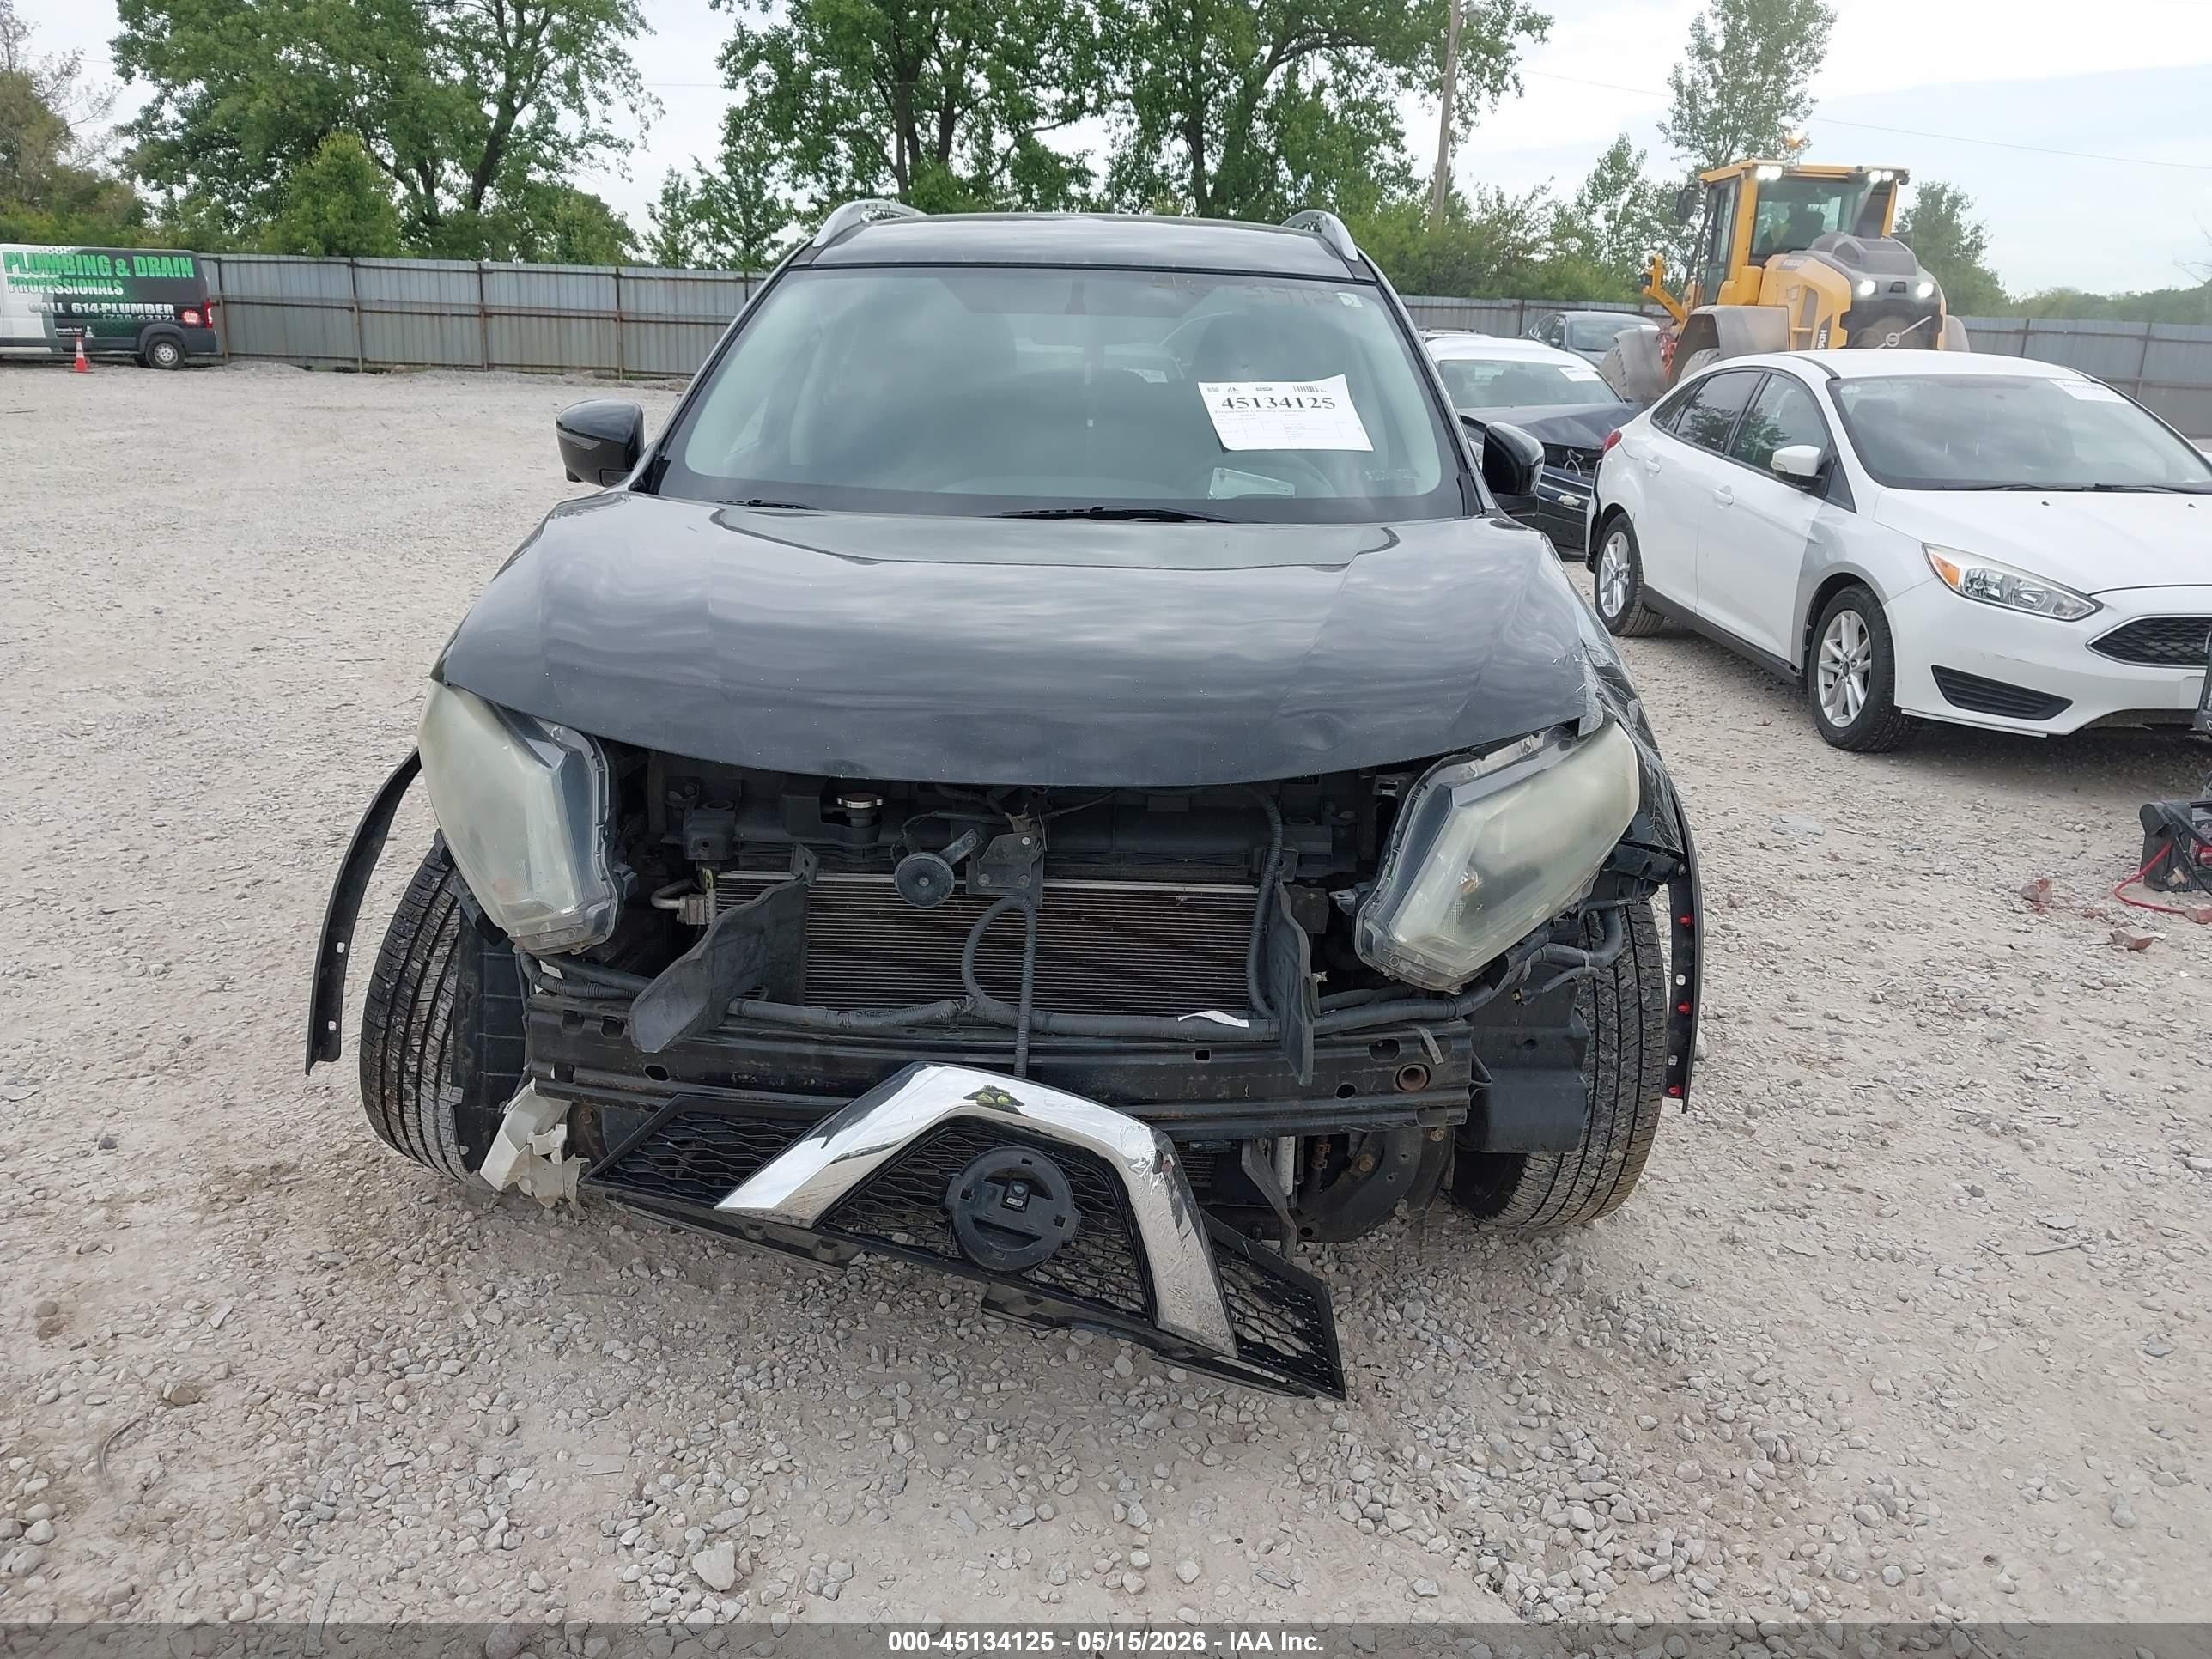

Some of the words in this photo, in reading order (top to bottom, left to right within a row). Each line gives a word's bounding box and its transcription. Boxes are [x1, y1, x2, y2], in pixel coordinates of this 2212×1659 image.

[2, 251, 112, 276] PLUMBING
[115, 258, 131, 276] &
[133, 255, 194, 278] DRAIN
[7, 276, 124, 295] PROFESSIONALS
[27, 301, 66, 313] CALL
[71, 301, 174, 314] 614-PLUMBER
[1221, 396, 1336, 410] 45134125
